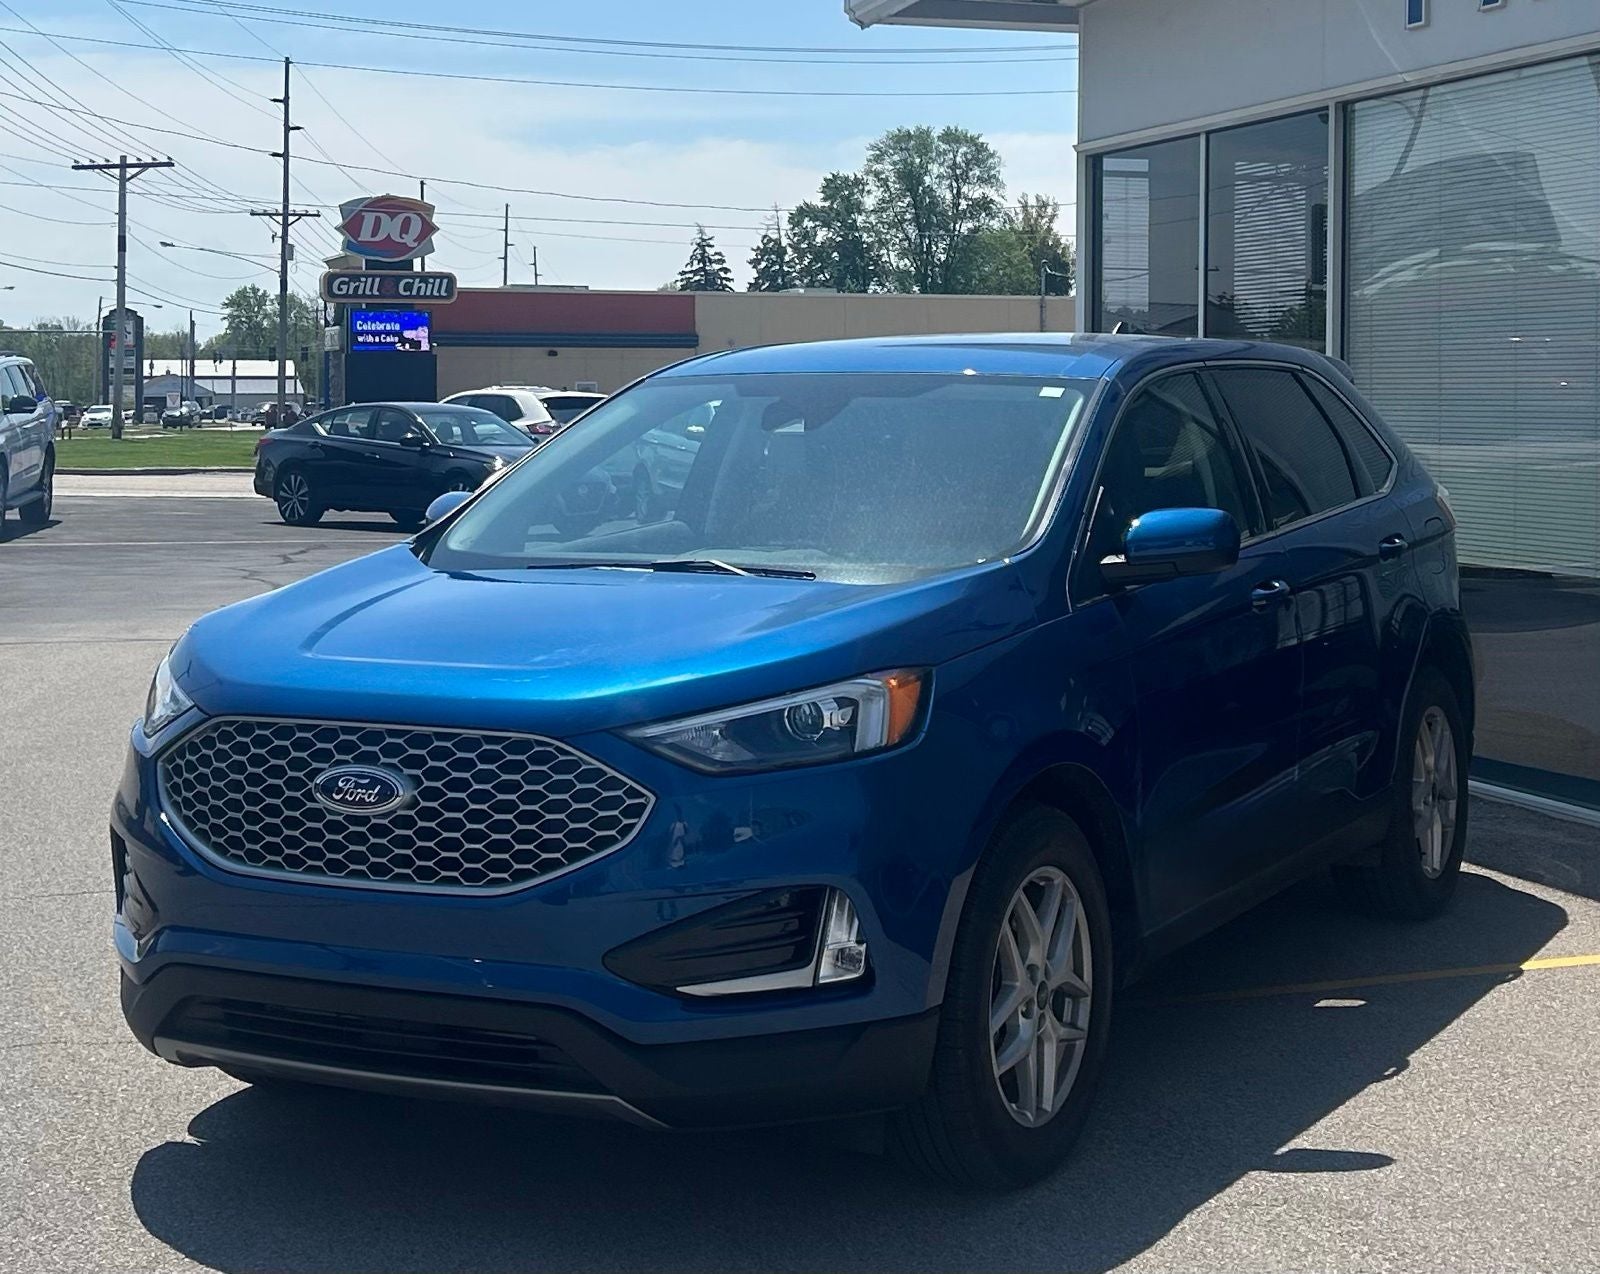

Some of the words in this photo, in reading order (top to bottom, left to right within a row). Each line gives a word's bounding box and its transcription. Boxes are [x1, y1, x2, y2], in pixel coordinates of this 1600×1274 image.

[358, 212, 422, 247] DQ
[332, 277, 380, 295] Grill
[398, 278, 449, 296] Chill
[356, 321, 400, 331] Celebrate
[357, 334, 374, 343] with
[380, 334, 399, 343] Cake
[332, 776, 381, 802] Ford
